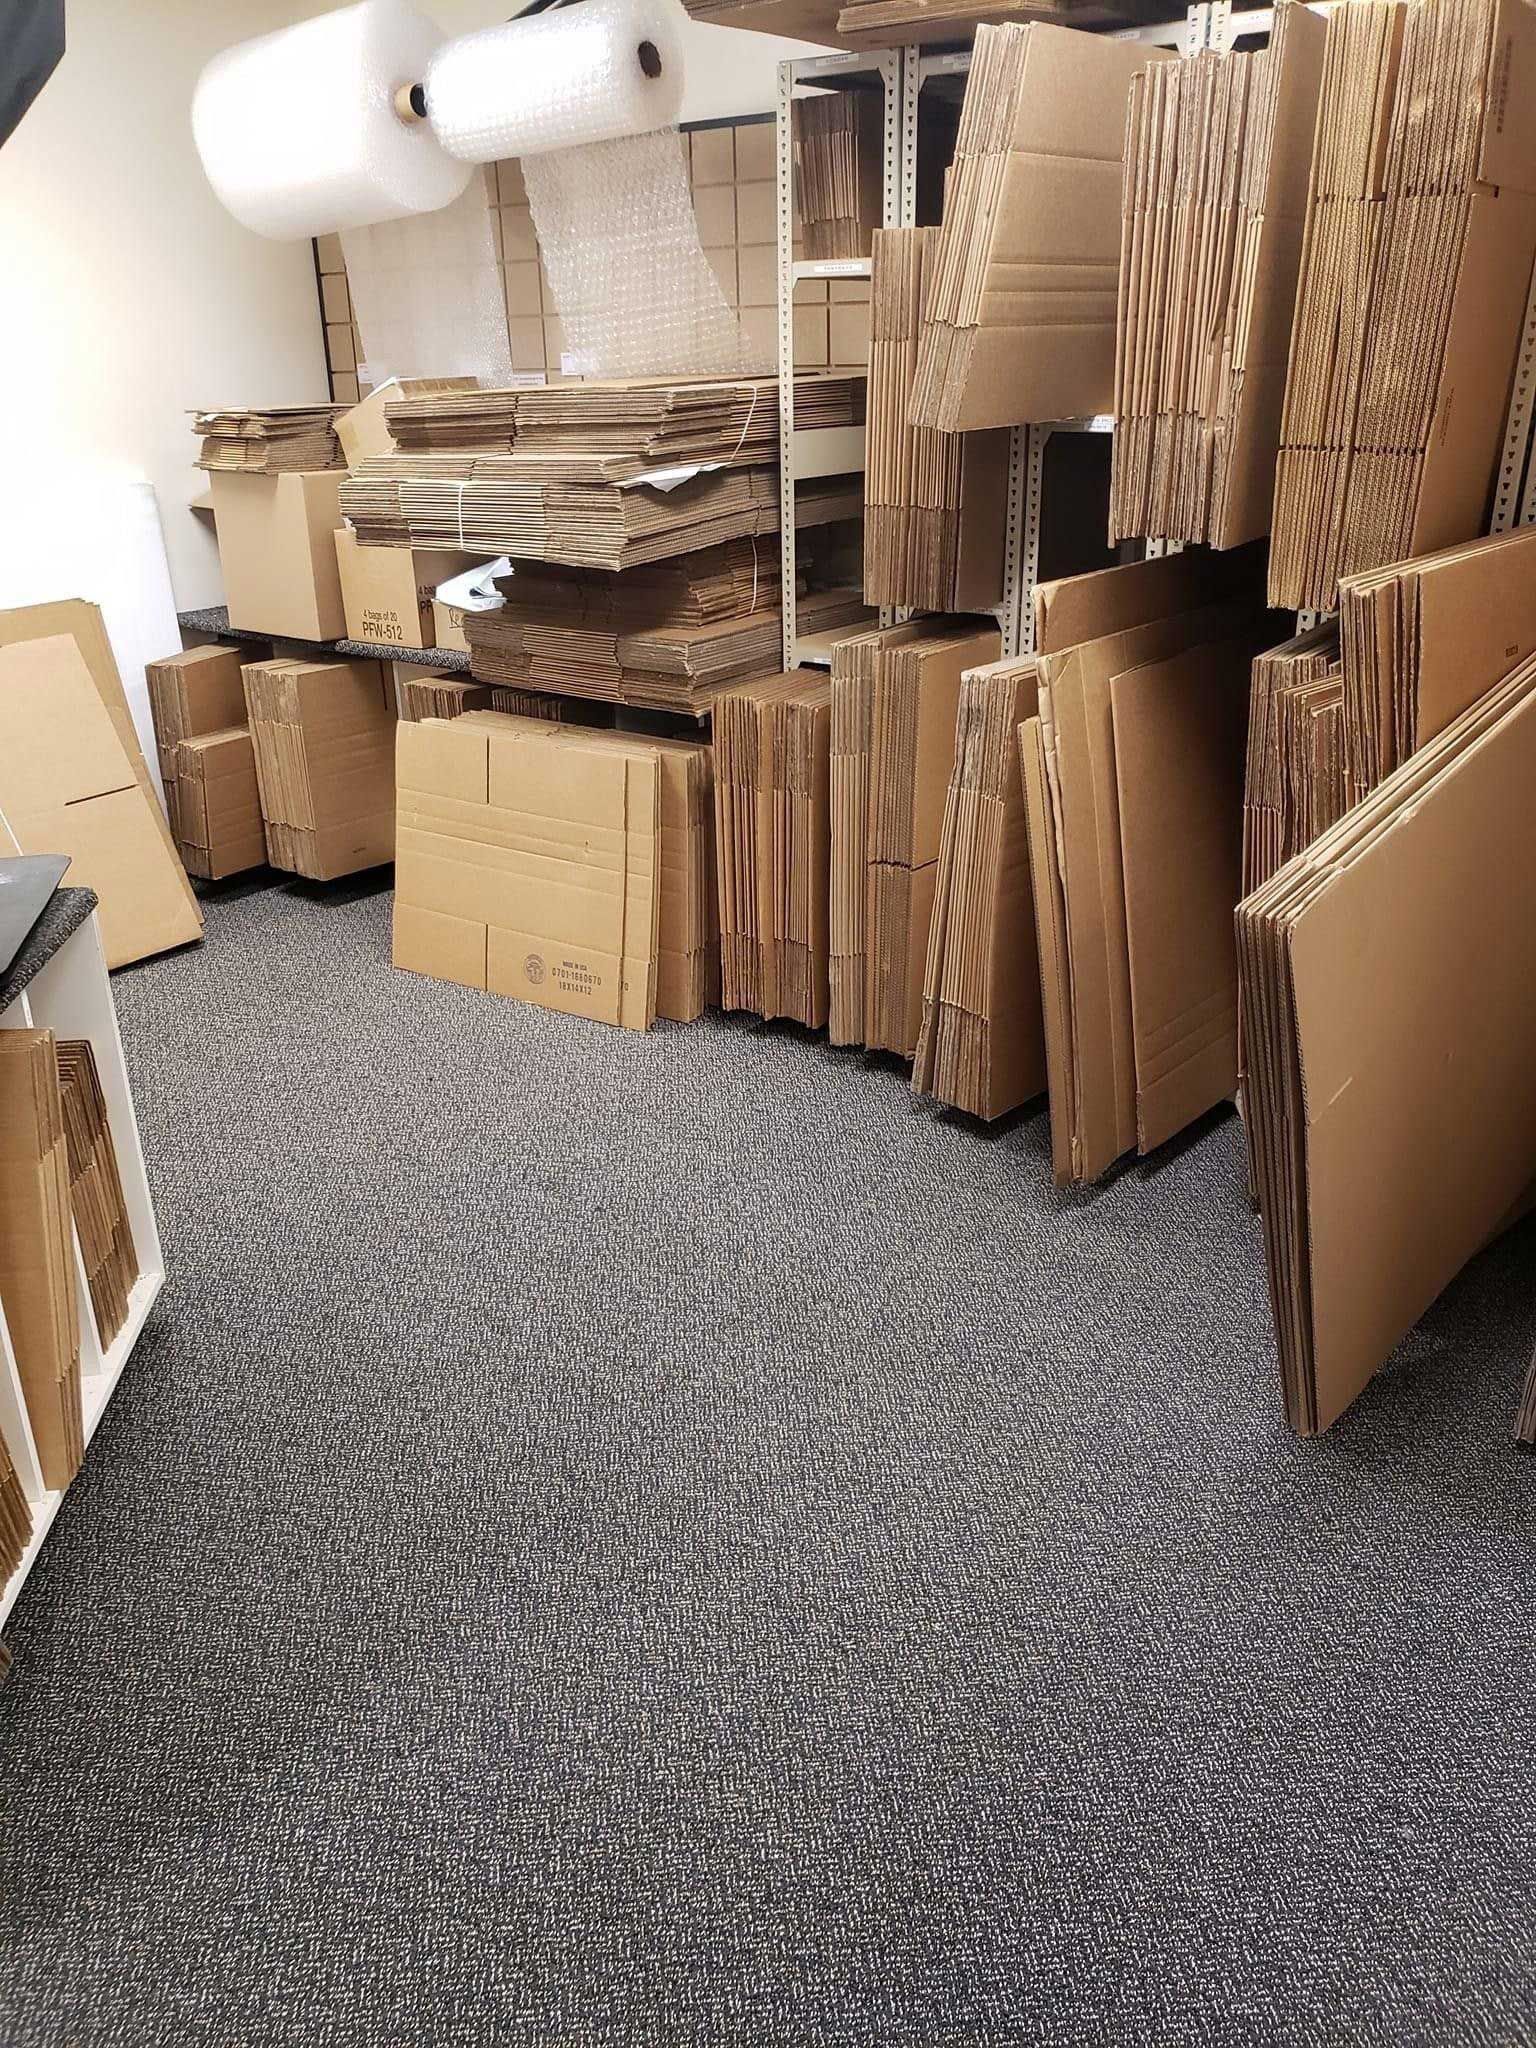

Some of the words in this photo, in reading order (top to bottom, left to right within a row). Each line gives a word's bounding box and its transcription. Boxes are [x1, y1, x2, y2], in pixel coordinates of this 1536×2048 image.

[363, 610, 368, 618] 4
[368, 610, 383, 622] bags
[383, 611, 389, 620] of
[390, 611, 398, 621] 20
[362, 621, 403, 640] PFW-512
[559, 981, 592, 995] 18X14X12
